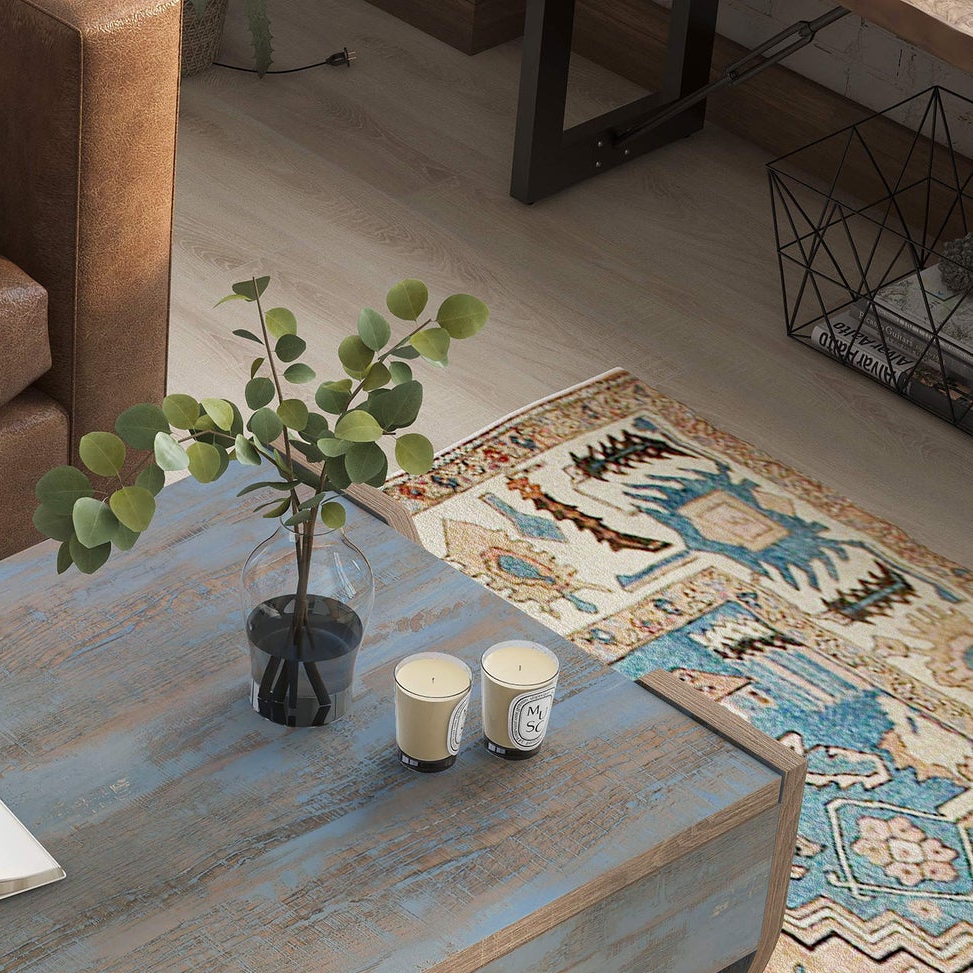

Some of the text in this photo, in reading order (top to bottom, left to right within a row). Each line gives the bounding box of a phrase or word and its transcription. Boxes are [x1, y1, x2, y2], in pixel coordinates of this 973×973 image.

[833, 322, 876, 345] Aalto
[870, 344, 914, 366] Alvar
[857, 353, 897, 386] Alvar
